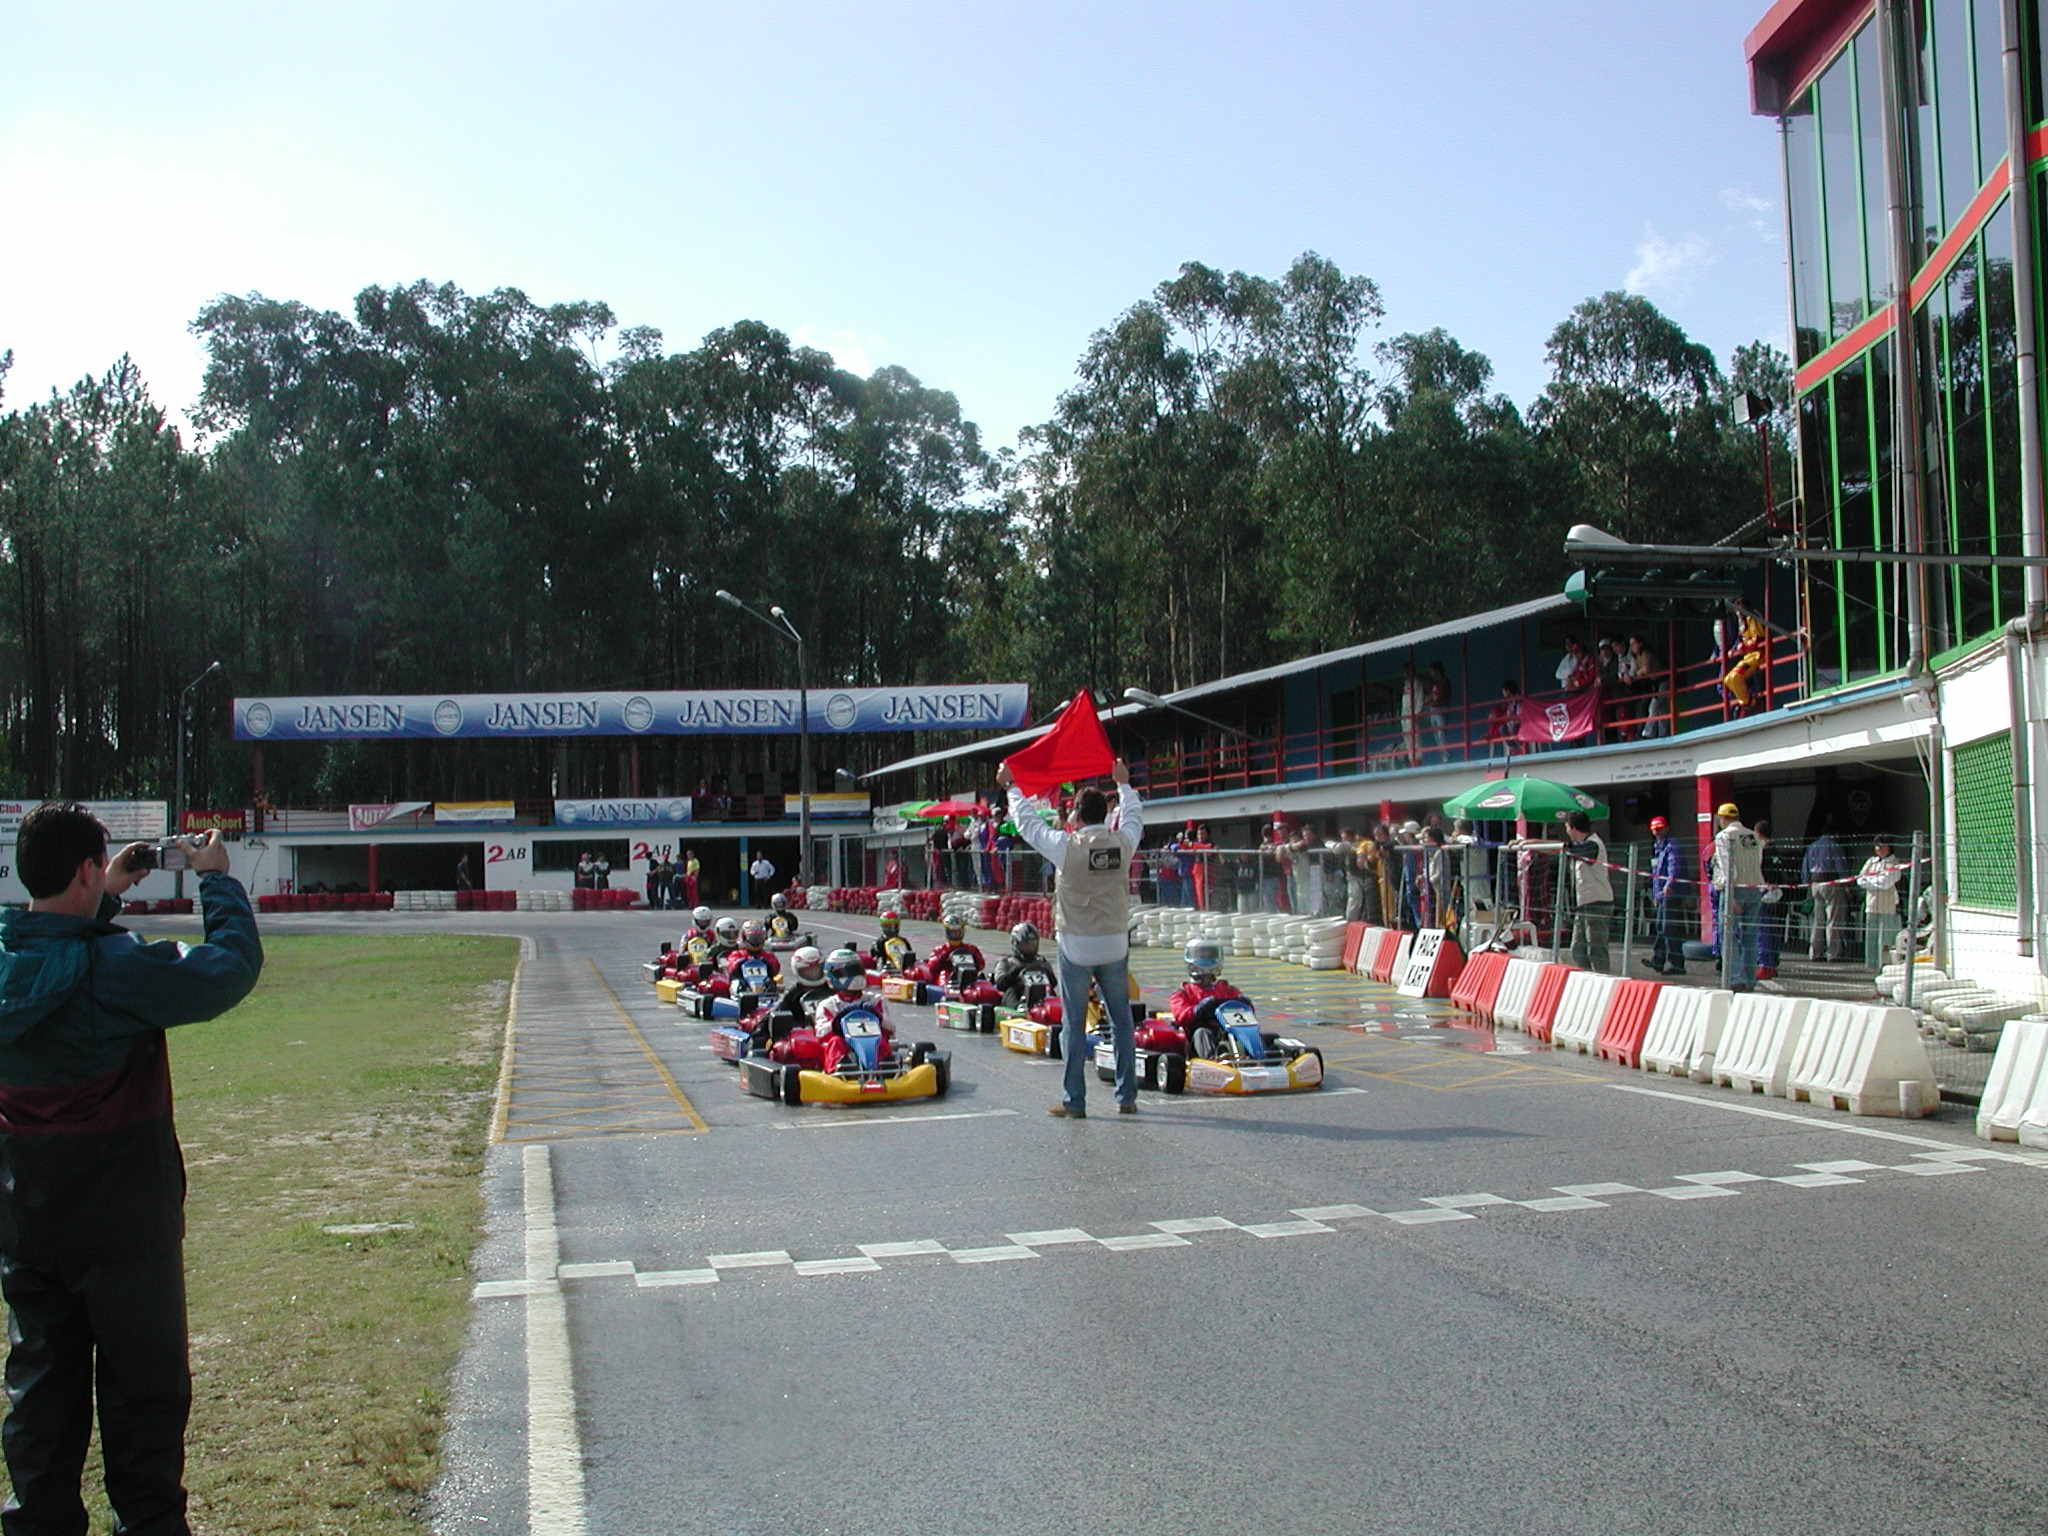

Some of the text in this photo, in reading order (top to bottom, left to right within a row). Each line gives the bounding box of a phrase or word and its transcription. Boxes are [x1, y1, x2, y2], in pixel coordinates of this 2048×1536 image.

[488, 701, 598, 727] JANSEN
[680, 699, 795, 724] JANSEN
[884, 693, 1001, 720] JANSEN
[297, 704, 403, 729] JANSEN
[587, 803, 658, 819] JANSEN
[186, 813, 242, 830] AutoSport
[749, 968, 762, 976] 11
[1026, 975, 1044, 983] 12
[1404, 965, 1430, 988] KART
[1233, 1013, 1247, 1023] 3
[859, 1023, 867, 1033] 1
